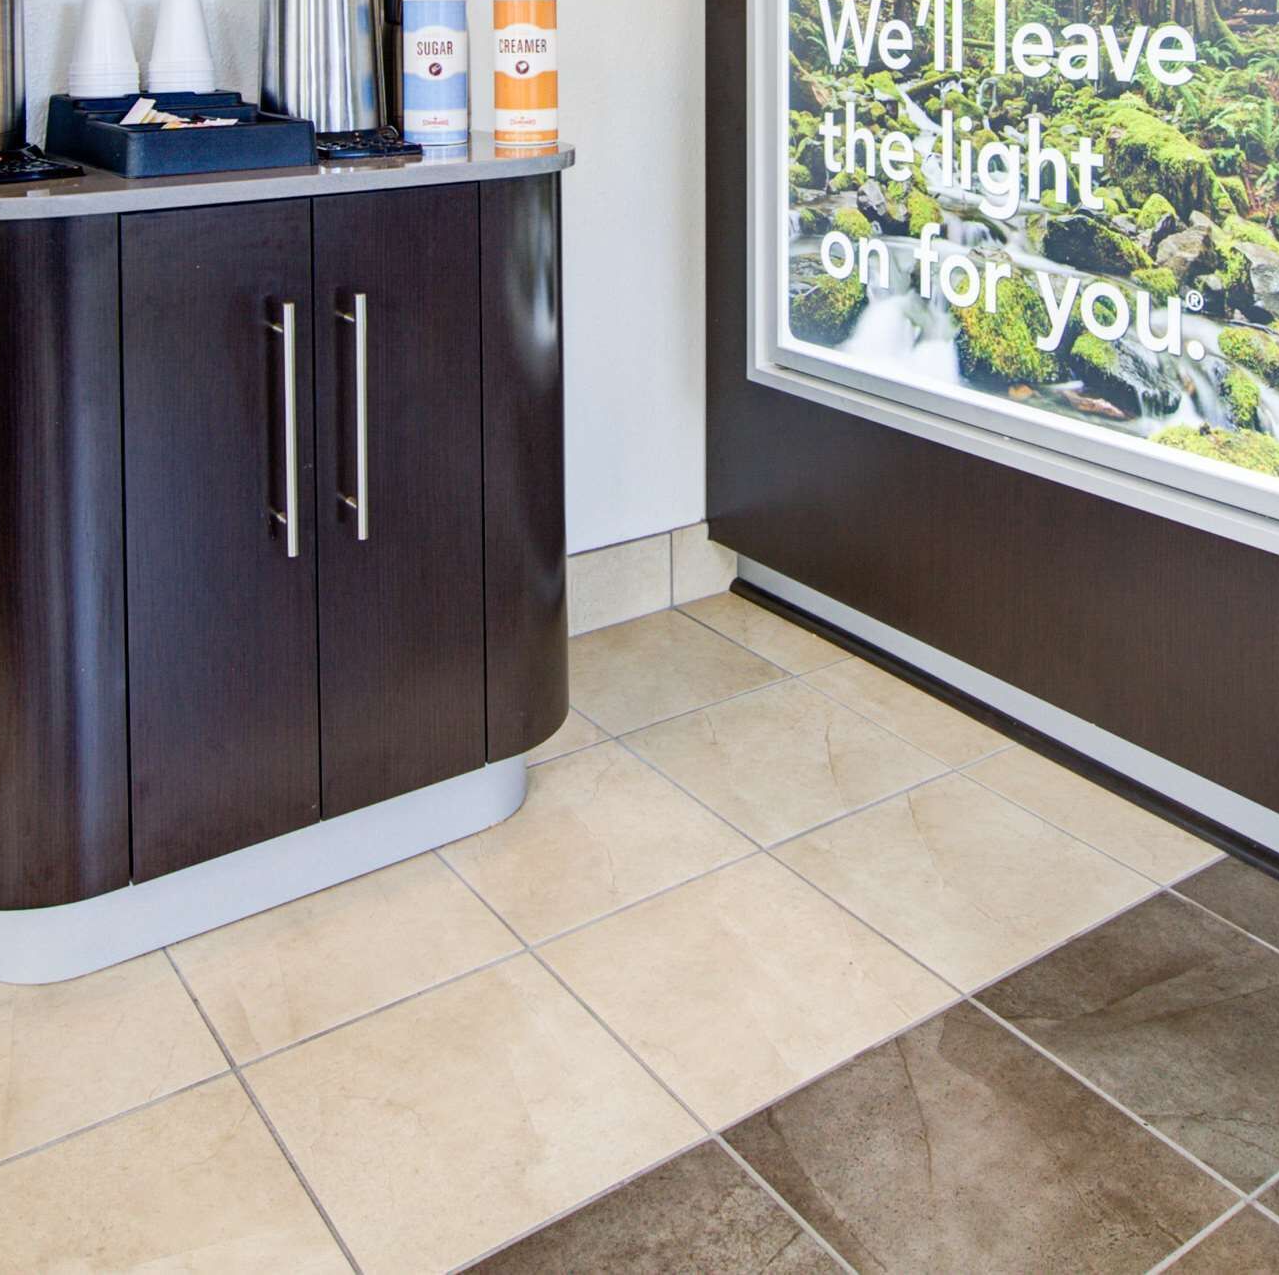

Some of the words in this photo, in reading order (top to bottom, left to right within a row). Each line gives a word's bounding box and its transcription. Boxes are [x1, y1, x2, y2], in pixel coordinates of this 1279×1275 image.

[416, 40, 454, 56] SUGAR
[498, 38, 548, 54] CREAMER
[818, 100, 916, 183] the
[941, 109, 1105, 220] light
[819, 228, 890, 290] on
[913, 221, 1012, 315] for
